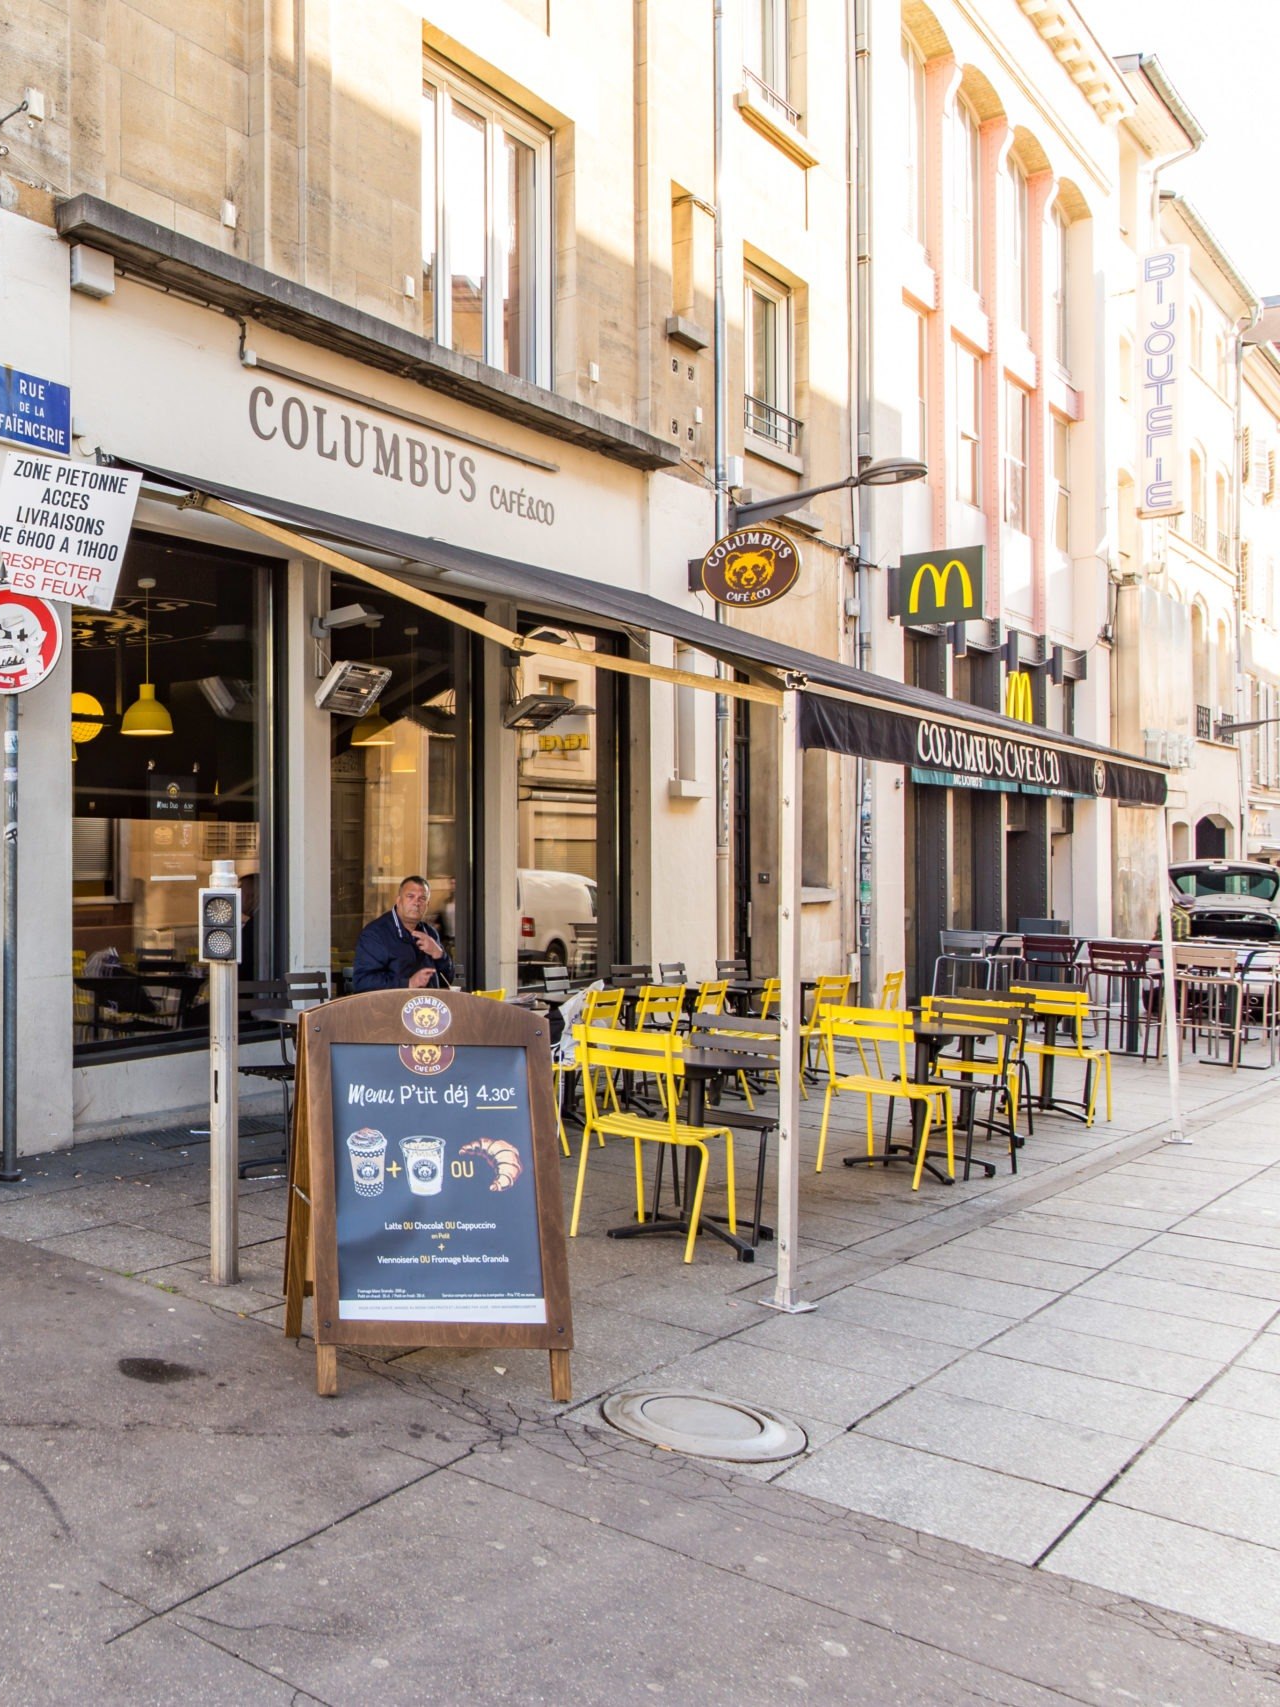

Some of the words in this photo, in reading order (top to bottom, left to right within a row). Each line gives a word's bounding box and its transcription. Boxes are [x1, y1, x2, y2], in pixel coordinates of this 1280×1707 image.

[19, 379, 45, 401] RUE
[19, 401, 30, 414] DE
[34, 405, 45, 418] LA
[249, 385, 477, 503] COLUMBUS
[489, 485, 556, 527] CAFÉ&CO
[14, 459, 53, 482] ZONE
[55, 467, 129, 495] PIETONNE
[41, 488, 90, 511] ACCES
[16, 506, 105, 536] LIVRAISONS
[17, 530, 55, 551] 6H00
[59, 537, 69, 554] A
[77, 539, 119, 562] 11H00
[706, 532, 792, 567] COLUMBUS
[1, 552, 102, 582] RESPECTER
[13, 572, 36, 589] ES
[41, 577, 88, 599] FEUX
[405, 997, 448, 1014] COLUMBUS
[348, 1083, 395, 1107] Menu
[400, 1084, 439, 1104] P'tit
[444, 1083, 468, 1108] déj
[476, 1085, 515, 1102] 4.30€
[451, 1160, 474, 1178] OU
[384, 1222, 402, 1230] Latte
[403, 1222, 413, 1230] OU
[414, 1221, 444, 1230] Chocolat
[445, 1221, 456, 1230] OU
[456, 1221, 496, 1231] Cappuccino
[377, 1255, 419, 1264] Viennoiserie
[420, 1255, 430, 1264] OU
[431, 1255, 461, 1265] Fromage
[462, 1255, 481, 1263] blanc
[482, 1254, 509, 1263] Granola
